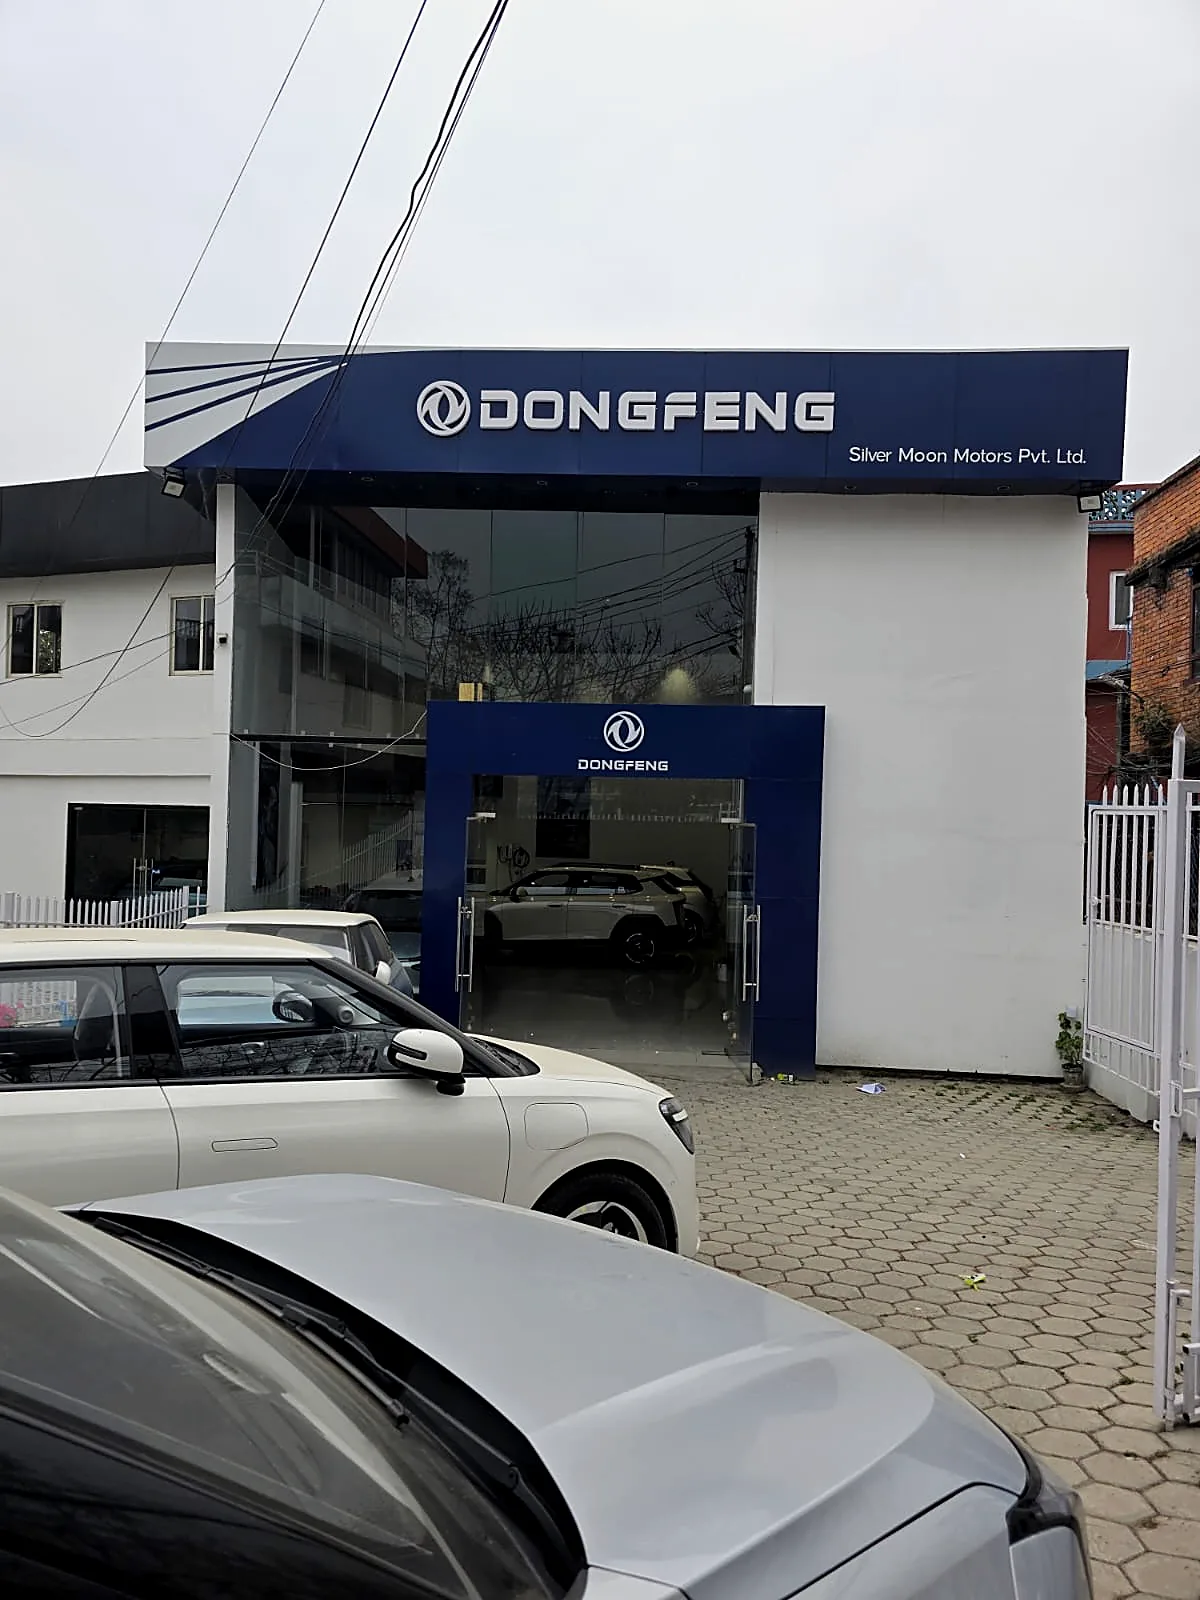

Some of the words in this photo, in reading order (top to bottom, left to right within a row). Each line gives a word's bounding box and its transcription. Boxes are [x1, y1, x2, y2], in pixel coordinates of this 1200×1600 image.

[479, 389, 836, 432] DONGFENG
[848, 446, 893, 463] Silver
[898, 447, 948, 463] Moon
[953, 448, 1013, 464] Motors
[1018, 448, 1051, 464] Pvt.
[1056, 448, 1087, 464] Ltd.
[578, 759, 669, 771] DONGFENG
